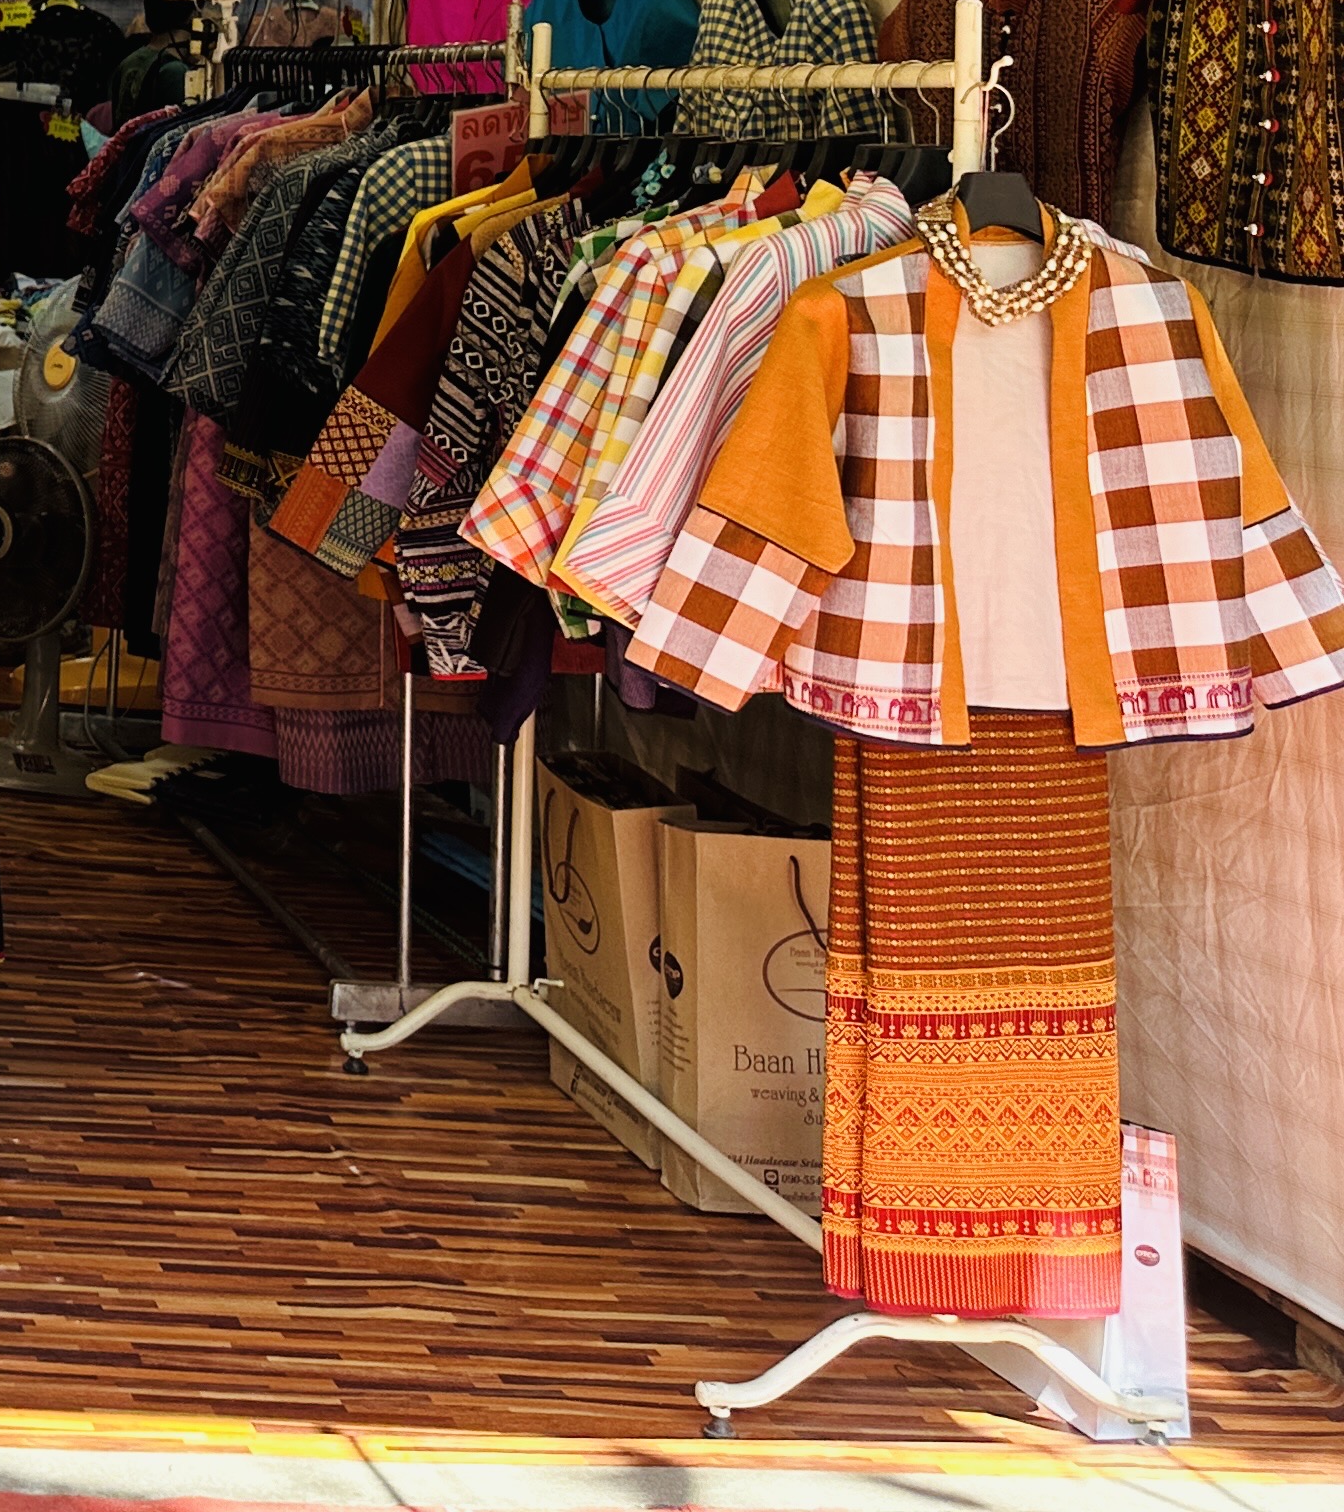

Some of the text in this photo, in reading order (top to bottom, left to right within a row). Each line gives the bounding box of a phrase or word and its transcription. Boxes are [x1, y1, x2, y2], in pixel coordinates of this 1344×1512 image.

[733, 1044, 826, 1076] Baan H
[751, 1087, 819, 1107] weaving &
